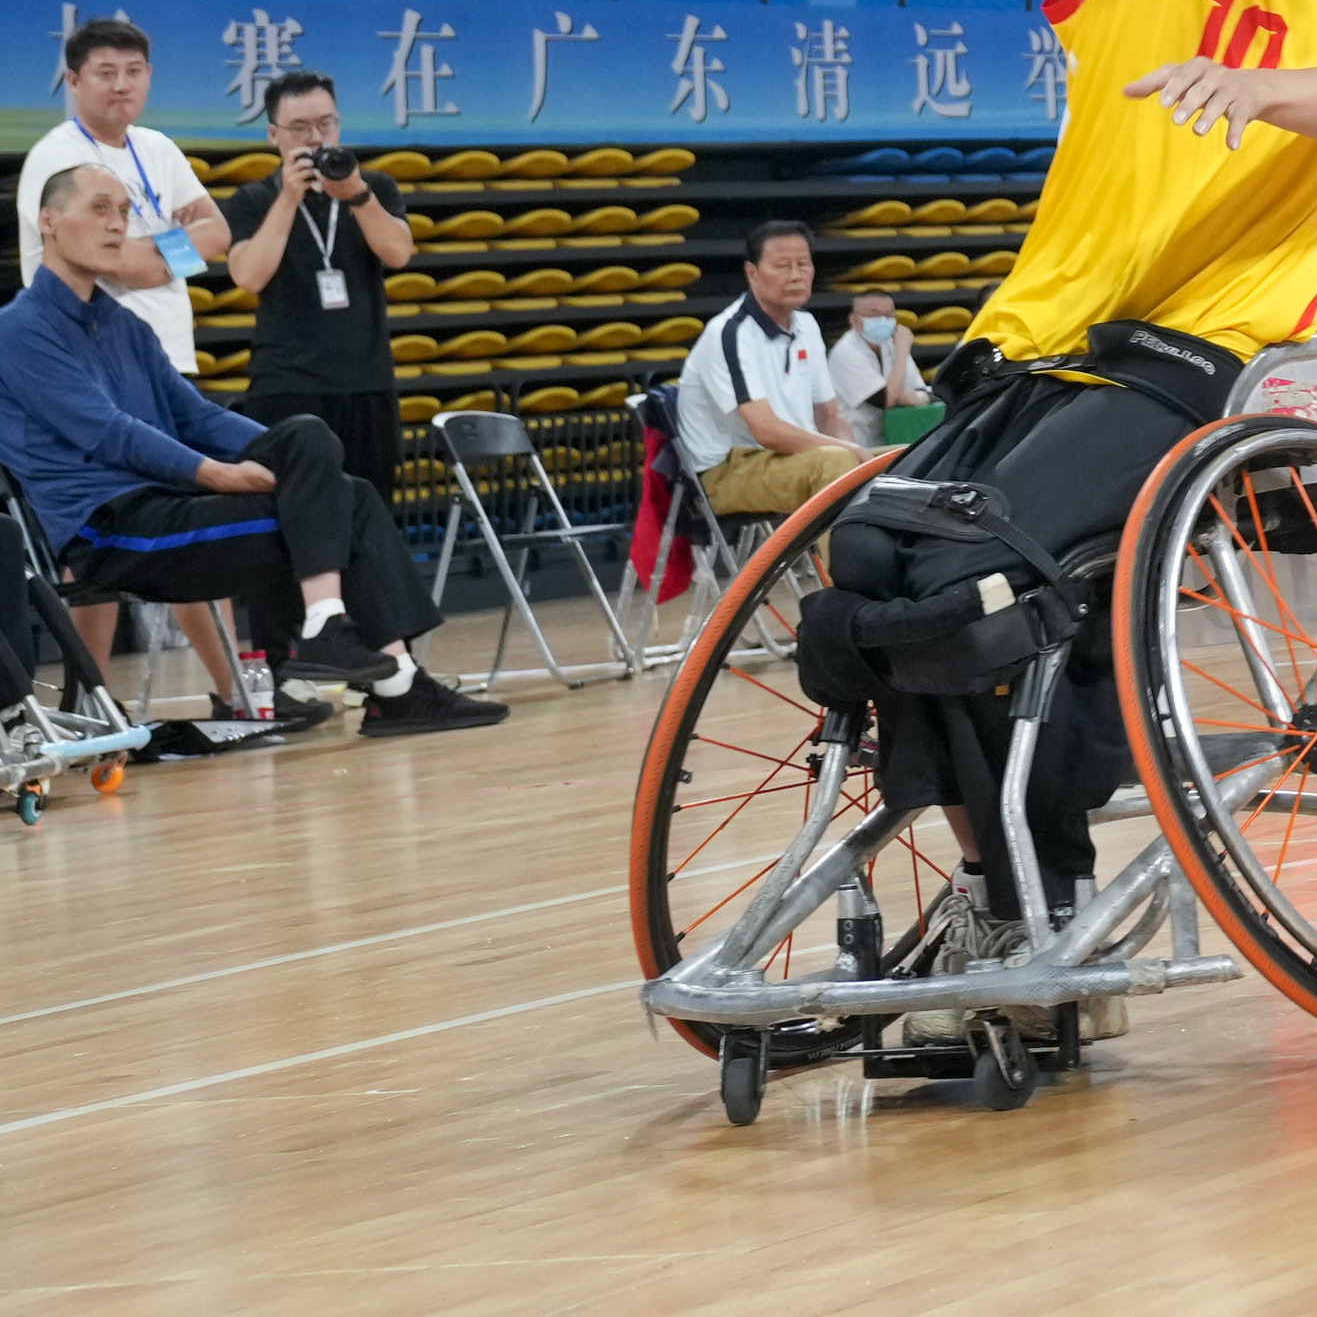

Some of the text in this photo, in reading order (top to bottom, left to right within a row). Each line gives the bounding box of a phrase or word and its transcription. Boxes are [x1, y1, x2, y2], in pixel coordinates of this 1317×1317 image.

[50, 2, 1067, 127] 赛在广东清远举
